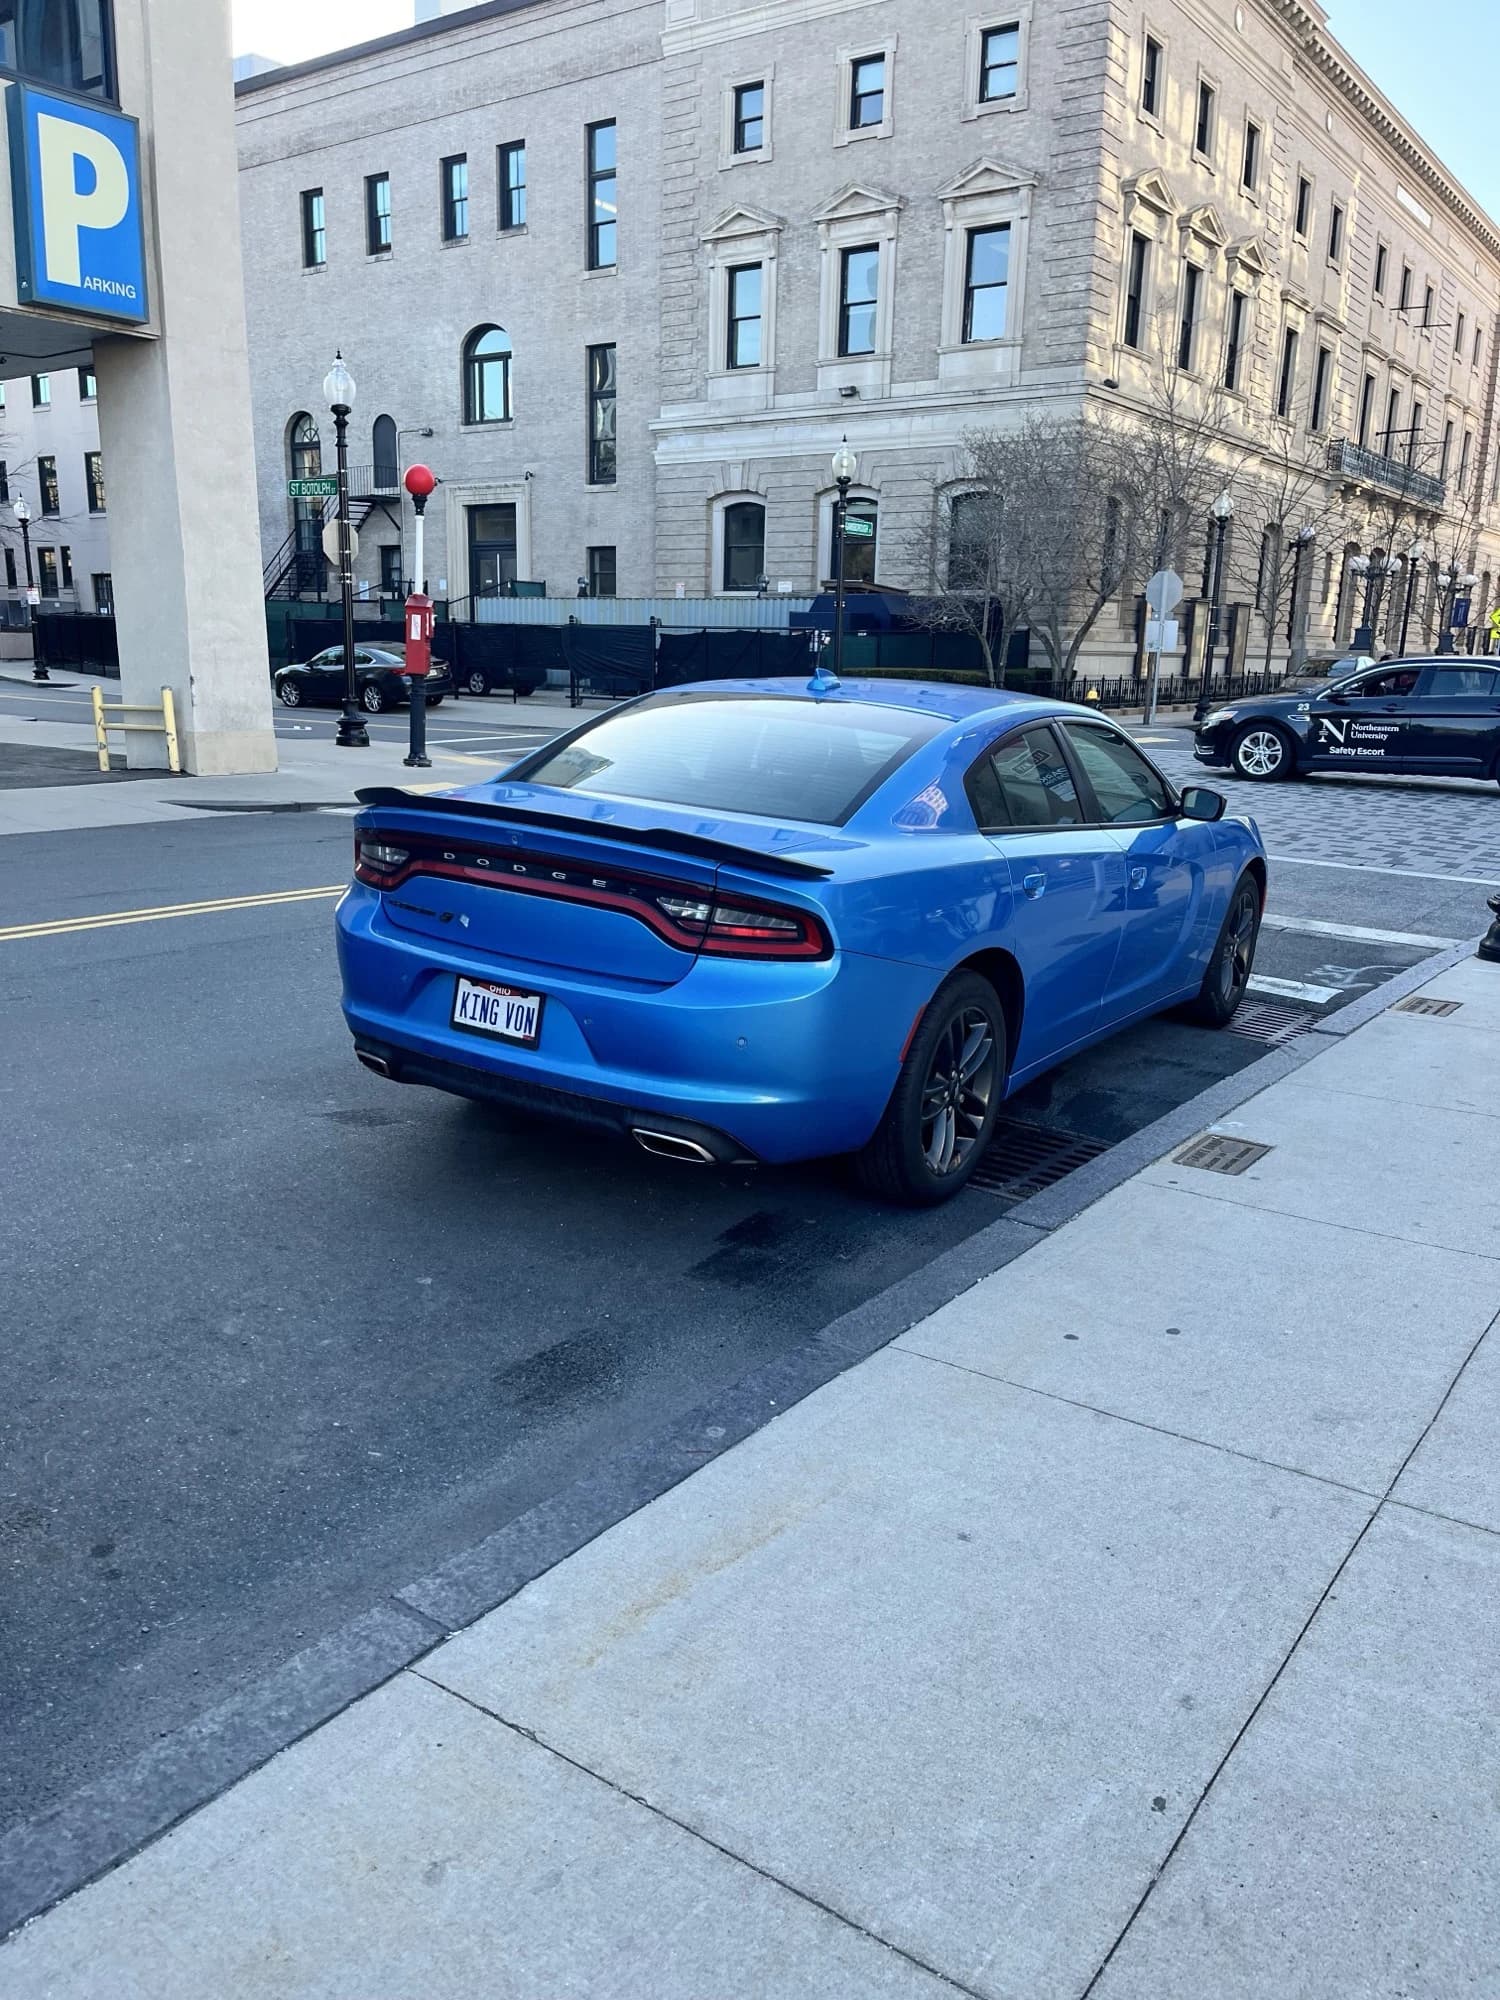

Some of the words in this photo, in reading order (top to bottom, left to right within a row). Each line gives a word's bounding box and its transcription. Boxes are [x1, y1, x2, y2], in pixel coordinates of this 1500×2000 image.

[290, 482, 300, 495] ST
[301, 482, 331, 495] BOTOLPH
[1297, 703, 1310, 711] 23
[1351, 723, 1400, 732] Northeastern
[1350, 731, 1389, 741] University
[1329, 746, 1356, 756] Safety
[1357, 747, 1385, 756] Escort
[443, 852, 607, 888] DODGE
[489, 984, 511, 996] OHIO
[460, 991, 500, 1026] KING
[505, 1001, 535, 1035] VON
